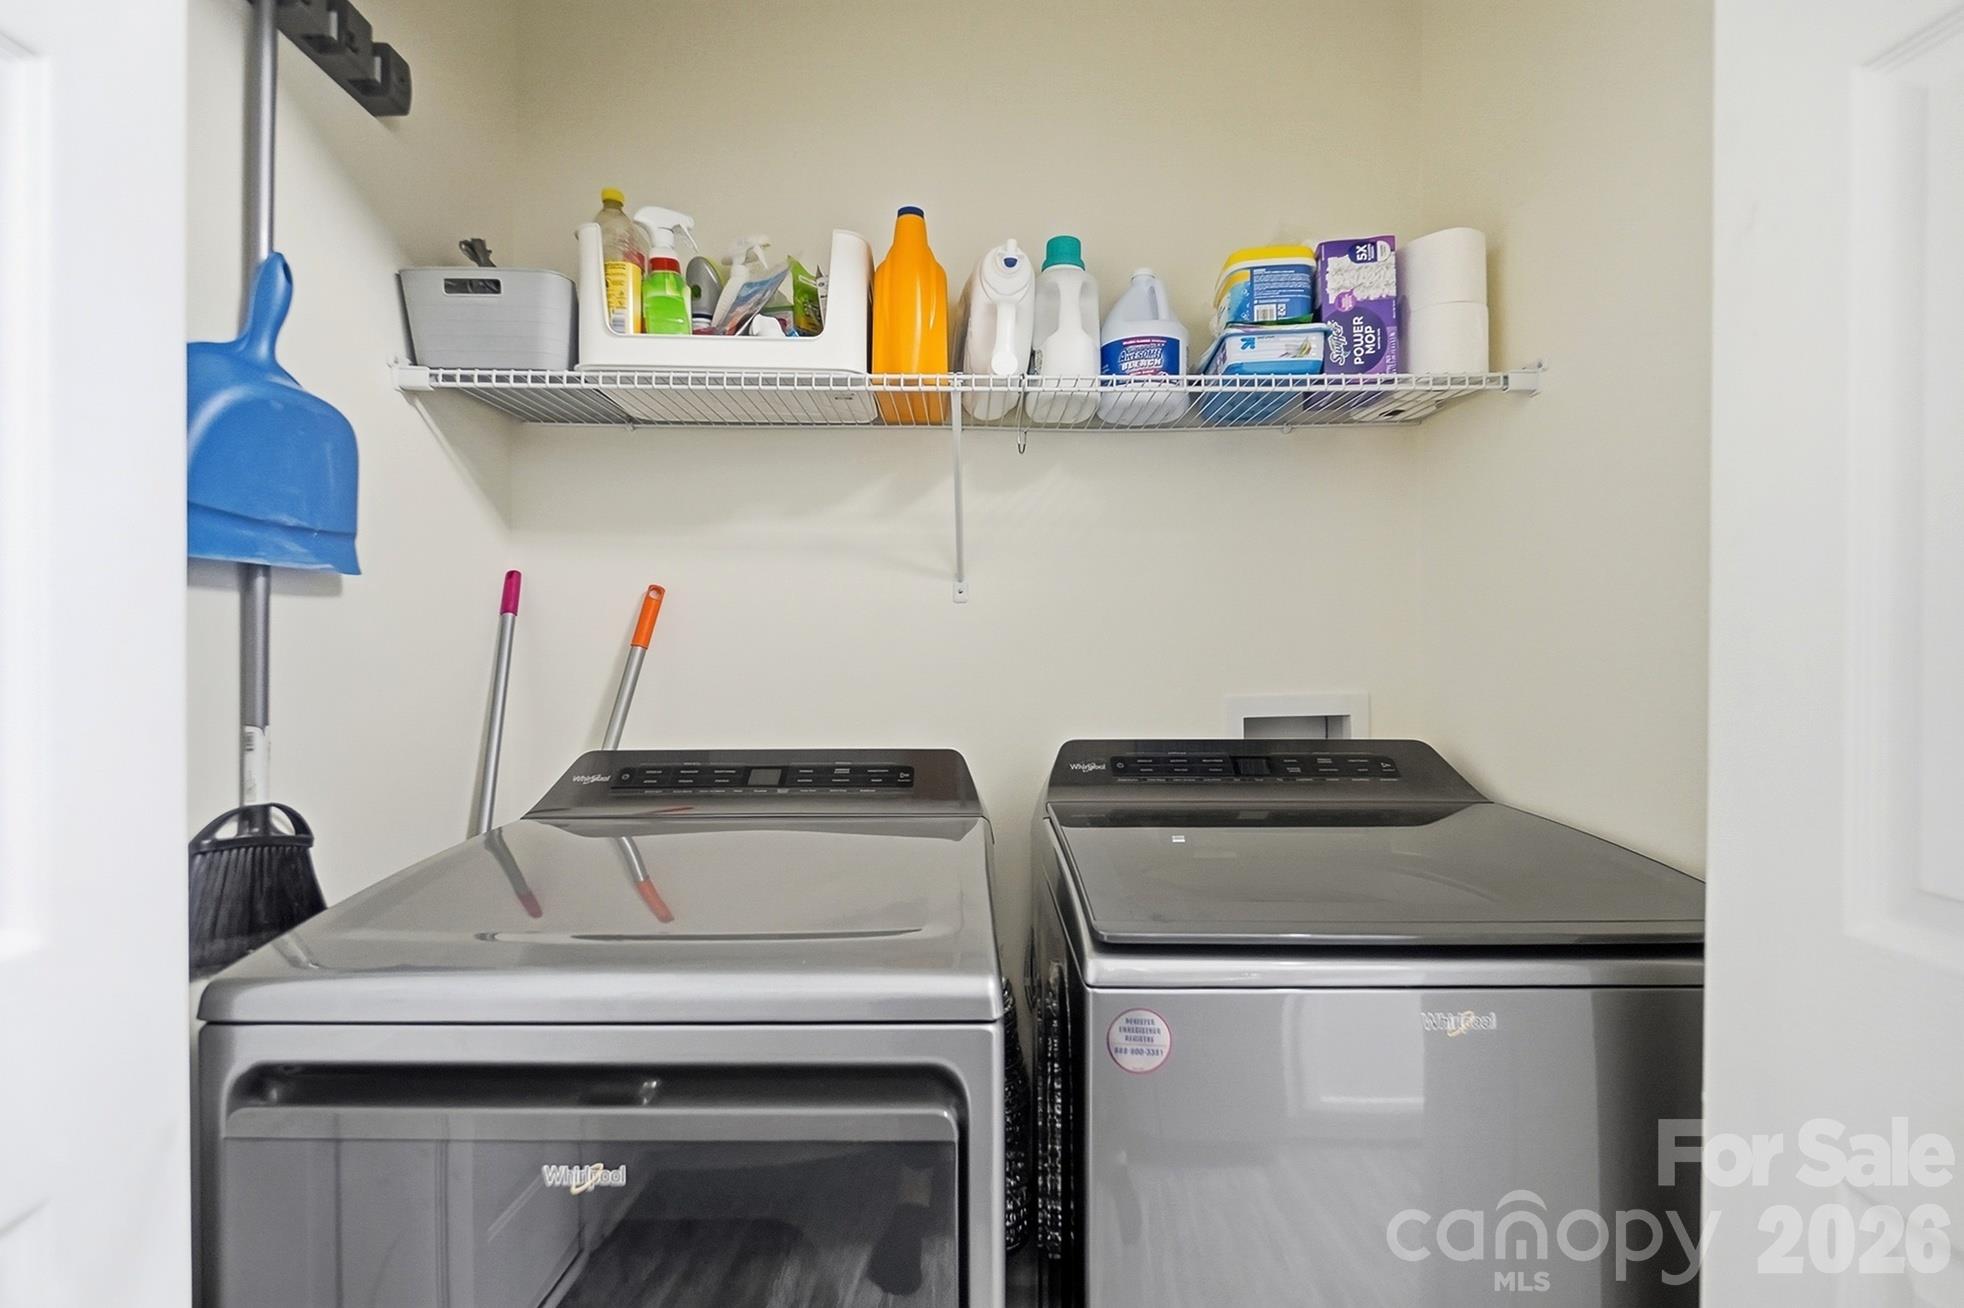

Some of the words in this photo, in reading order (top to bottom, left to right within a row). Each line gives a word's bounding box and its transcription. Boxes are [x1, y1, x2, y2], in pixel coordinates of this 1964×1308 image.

[1355, 244, 1367, 261] 5X
[1353, 316, 1364, 365] POWER
[1364, 325, 1376, 354] MOP
[1069, 762, 1107, 774] Whirlpool
[1420, 1010, 1497, 1037] Whirlpool
[542, 1163, 627, 1196] Whirlpool
